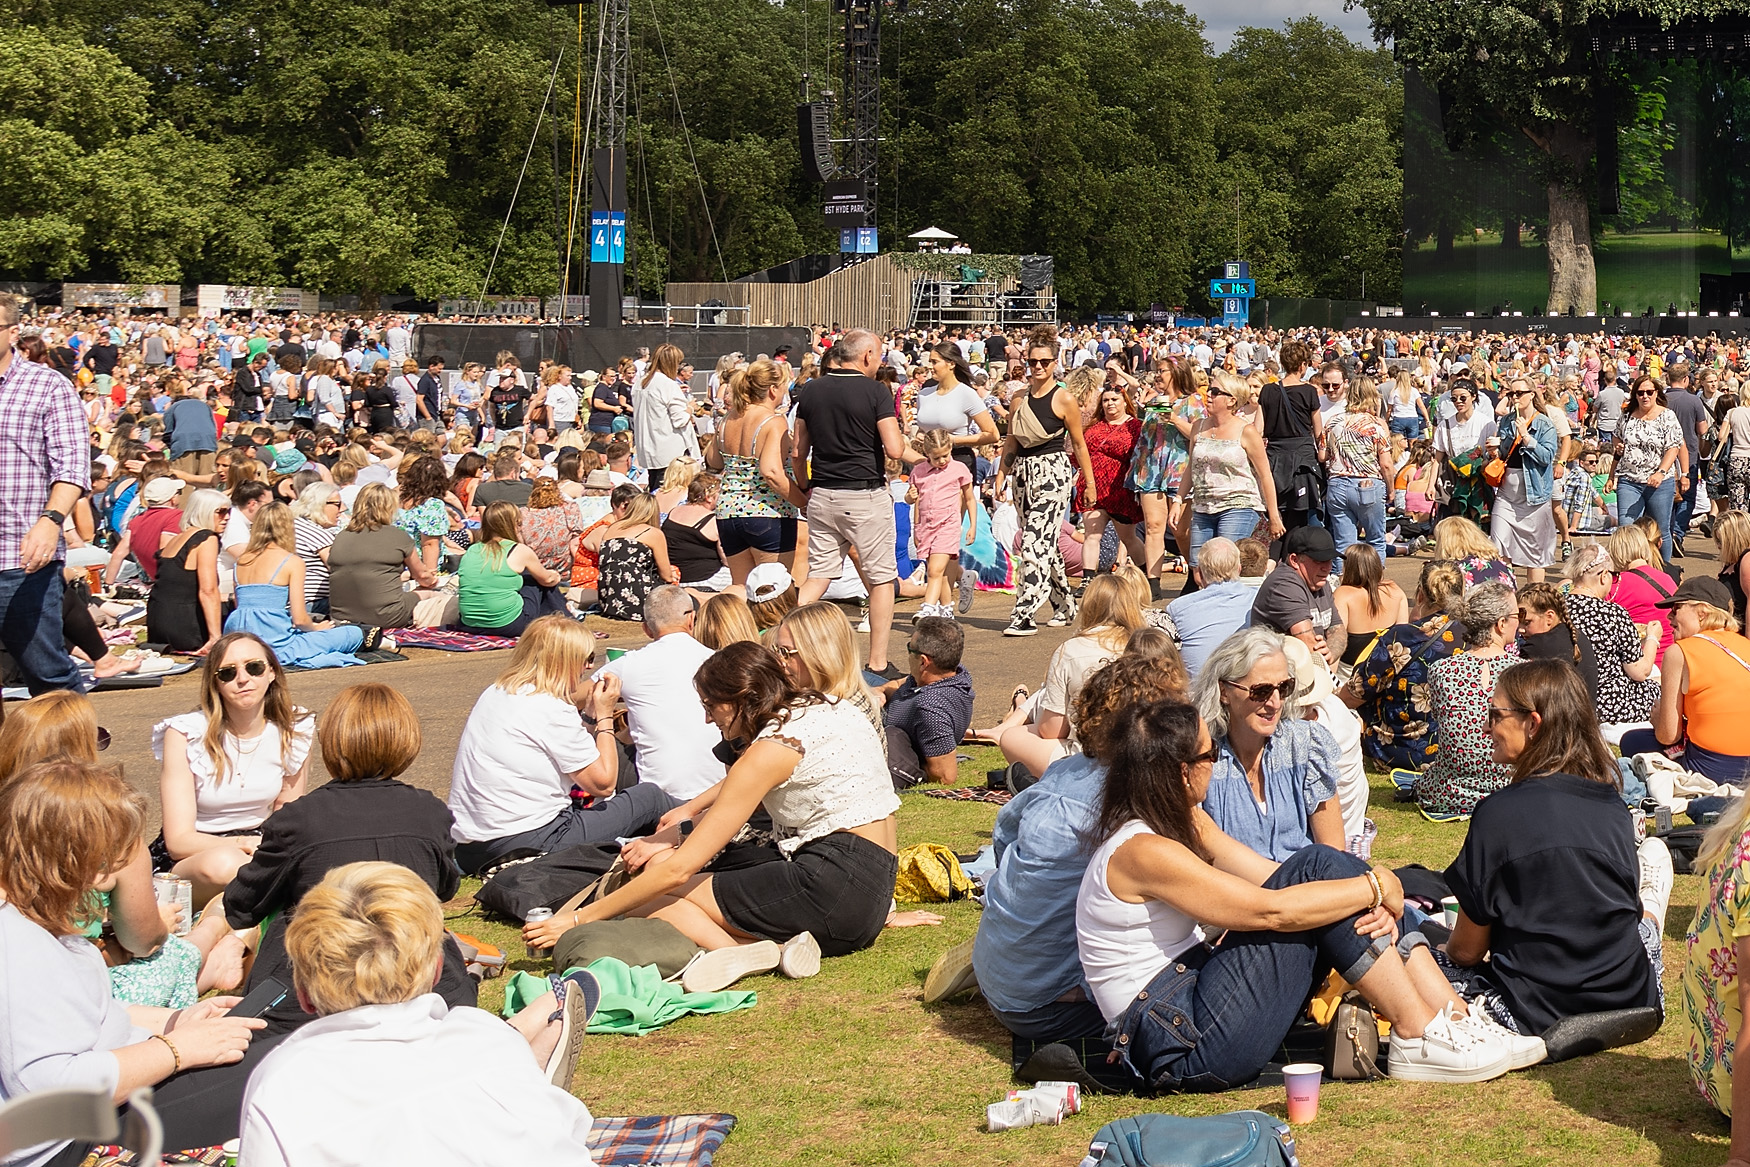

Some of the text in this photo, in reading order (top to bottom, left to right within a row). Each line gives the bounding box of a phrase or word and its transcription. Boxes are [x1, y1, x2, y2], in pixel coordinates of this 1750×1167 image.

[825, 205, 864, 214] BST HYDE PARK
[594, 229, 605, 247] 4
[613, 230, 622, 247] 4
[860, 236, 871, 245] 02
